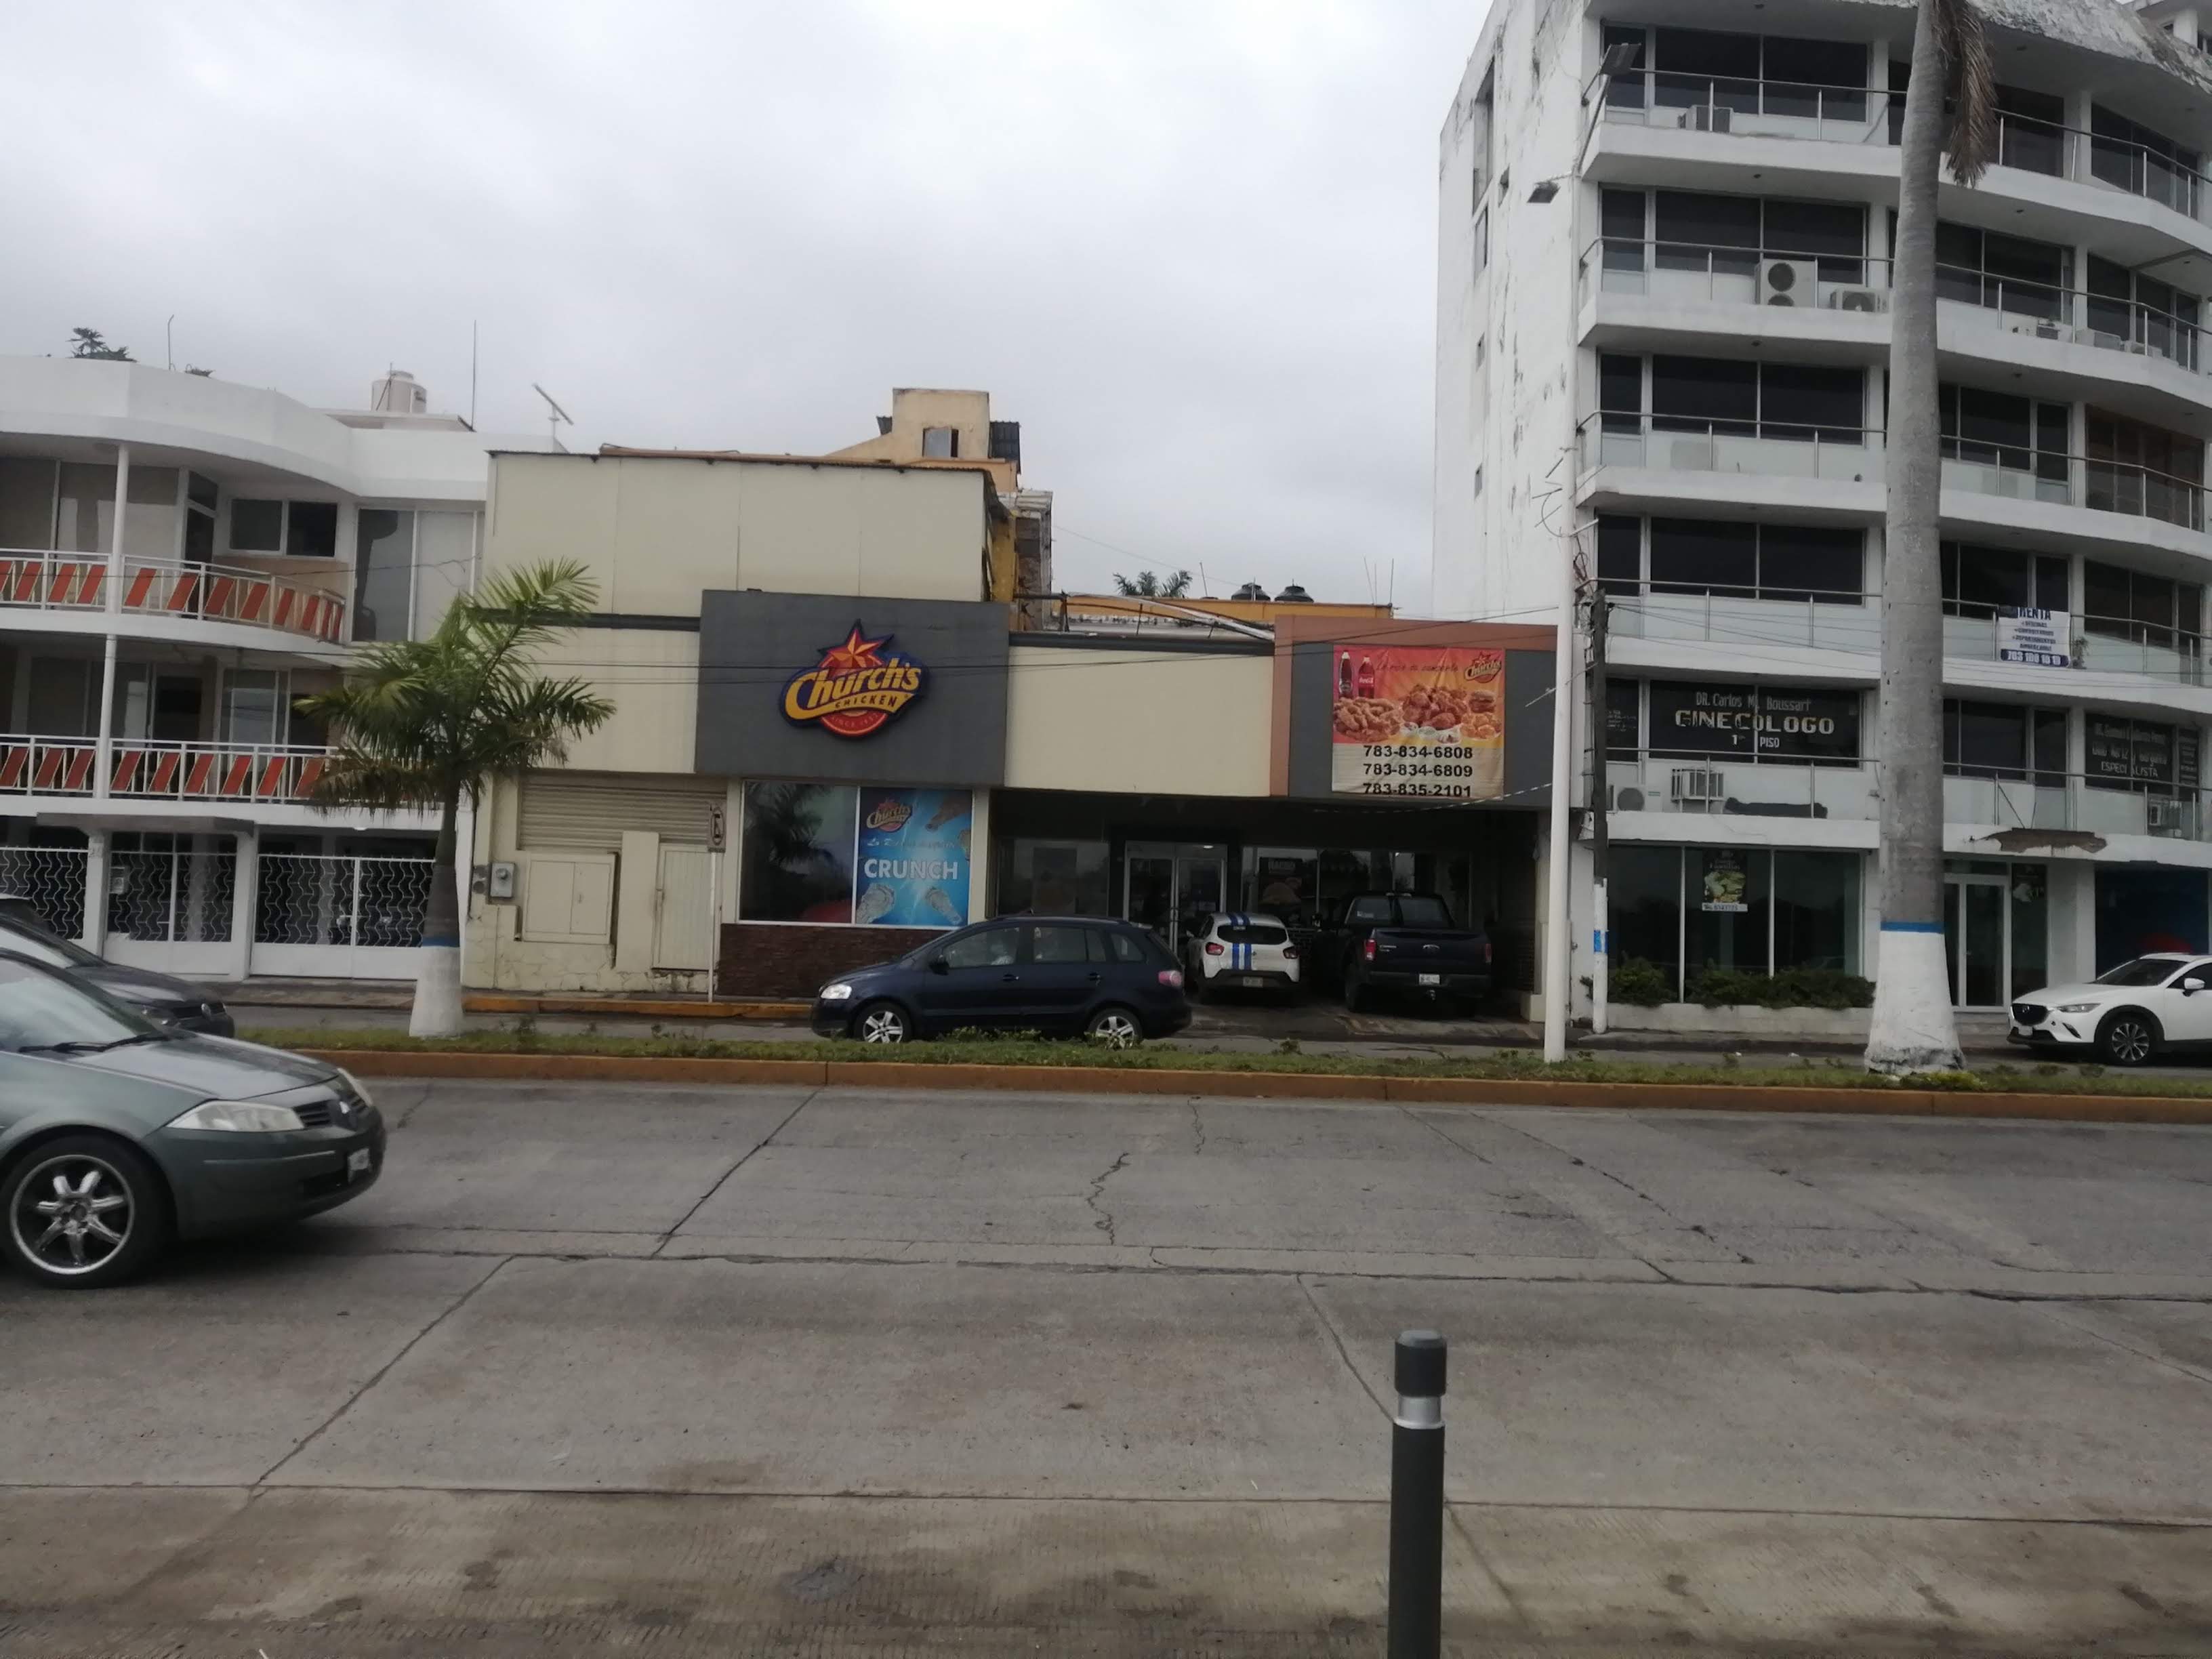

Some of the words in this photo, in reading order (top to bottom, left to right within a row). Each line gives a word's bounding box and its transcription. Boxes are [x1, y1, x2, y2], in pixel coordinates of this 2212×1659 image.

[785, 658, 921, 720] Church's
[836, 694, 897, 709] CHICKEN
[1713, 693, 1742, 708] Carlos
[1767, 696, 1811, 711] Boussart
[1675, 710, 1835, 735] GINECOLOGO
[1759, 737, 1780, 748] PISO
[1364, 745, 1473, 759] 783-834-6808
[1364, 763, 1473, 777] 783-834-6809
[1363, 783, 1471, 798] 783-835-2101
[864, 858, 958, 880] CRUNCH
